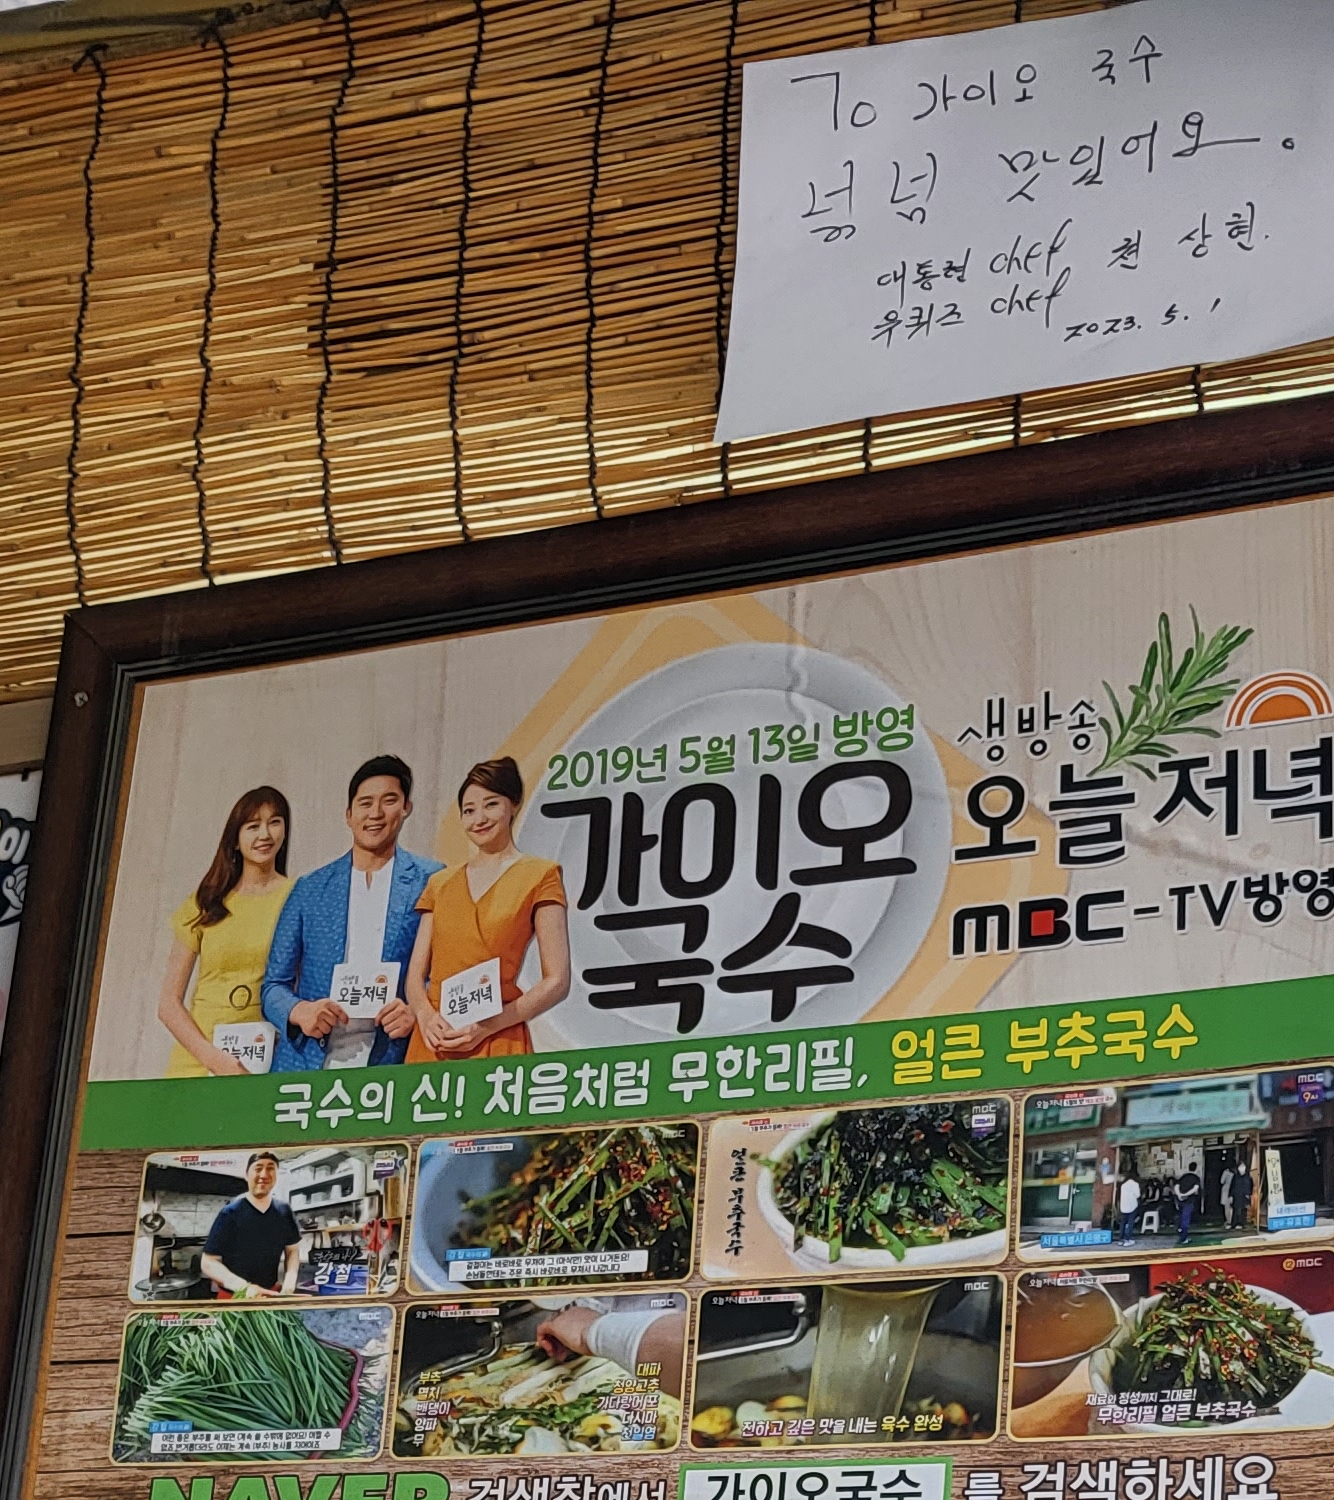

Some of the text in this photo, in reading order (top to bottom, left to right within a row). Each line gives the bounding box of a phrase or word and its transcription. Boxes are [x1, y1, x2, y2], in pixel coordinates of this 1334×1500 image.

[1092, 33, 1164, 85] 국수
[955, 696, 1103, 763] 생방송
[547, 702, 917, 792] 2019년 5월 13일 방영
[540, 758, 918, 912] 가이오
[581, 890, 857, 1036] 국수
[273, 1001, 1200, 1132] 국수의 신! 처음처럼 무한리필, 얼큰 부추국수
[419, 1371, 443, 1385] 부추
[635, 1362, 662, 1378] 대파
[417, 1386, 442, 1401] 멸치
[1084, 1387, 1198, 1407] 재료와 정성까지 그대로!
[414, 1416, 438, 1432] 양파
[621, 1410, 658, 1426] 다시마
[1096, 1399, 1258, 1425] 무한리필 얼큰 부추국수
[741, 1413, 945, 1439] 진하고 깊은 맛을 내는 육수 완성
[412, 1432, 426, 1447] 무
